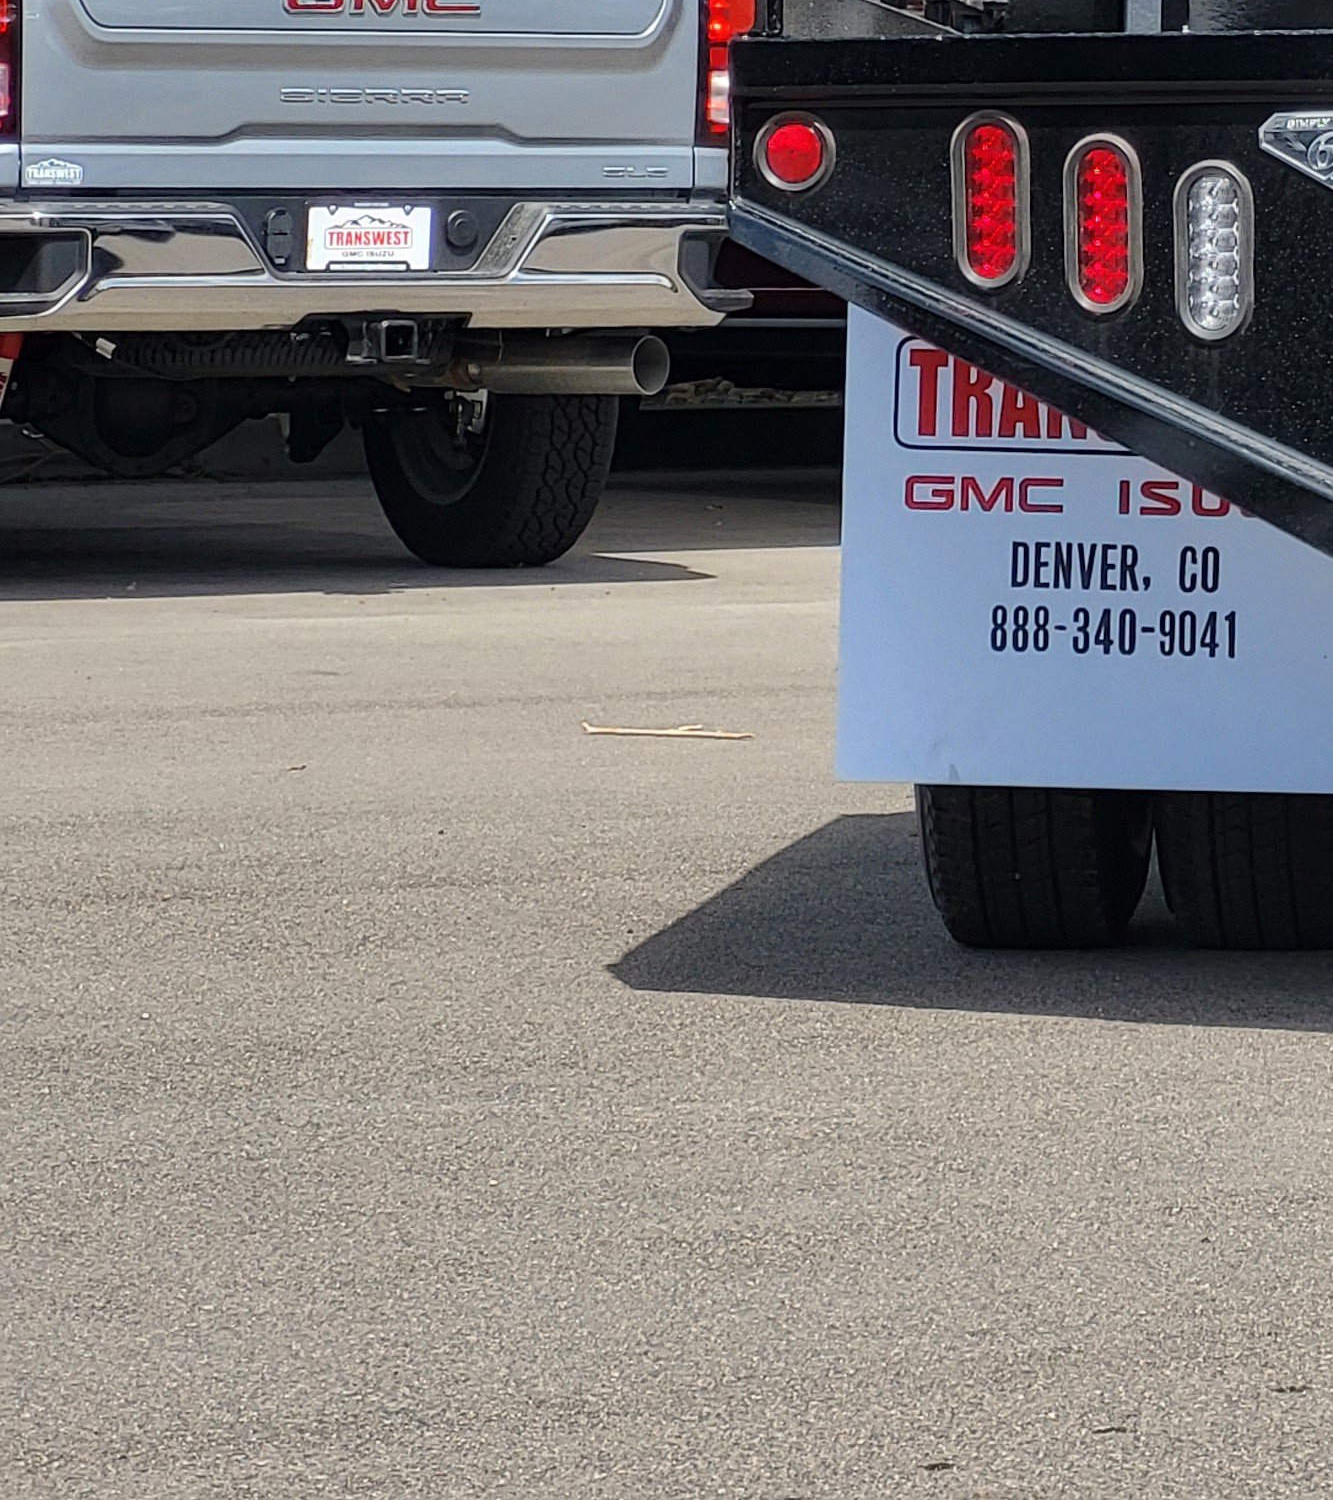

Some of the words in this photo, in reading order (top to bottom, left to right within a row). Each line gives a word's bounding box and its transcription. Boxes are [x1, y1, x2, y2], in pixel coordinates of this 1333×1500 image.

[280, 88, 470, 104] SIERRA
[28, 168, 81, 179] TRANSWEST
[328, 230, 410, 247] TRANSWEST
[342, 250, 364, 258] GMC
[904, 474, 1065, 513] GMC
[1118, 477, 1257, 518] ISU
[1010, 541, 1152, 592] DENVER,
[1179, 546, 1221, 594] CO
[990, 605, 1237, 659] 888-340-9041
